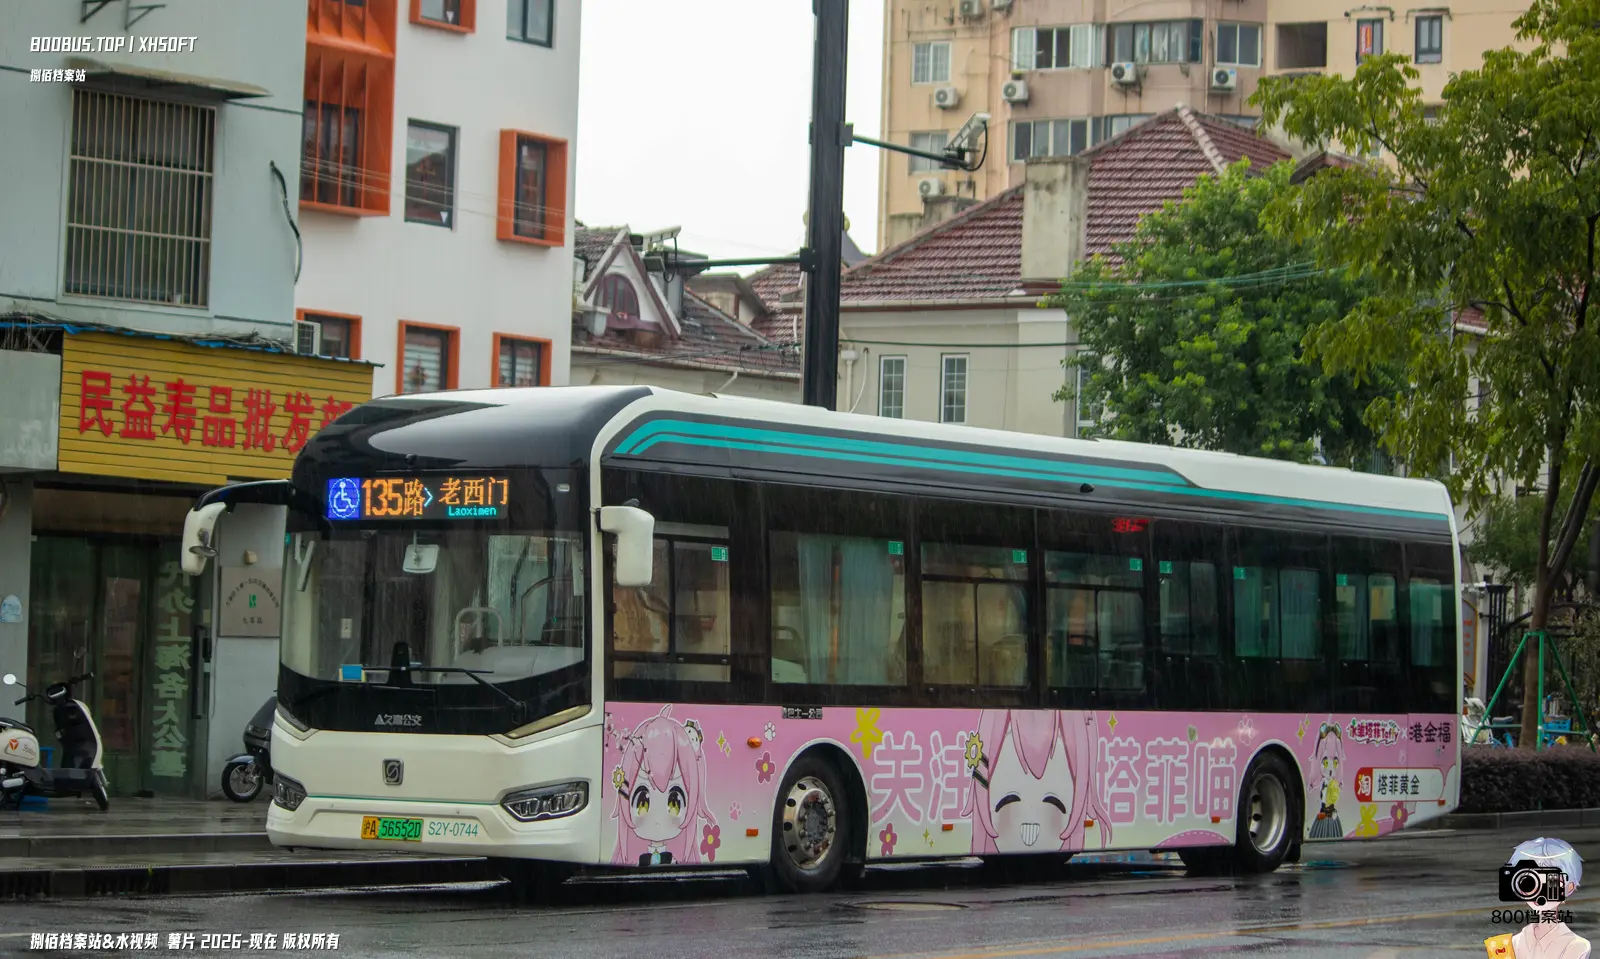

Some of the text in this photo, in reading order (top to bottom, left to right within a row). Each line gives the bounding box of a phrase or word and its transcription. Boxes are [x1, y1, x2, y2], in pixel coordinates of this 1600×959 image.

[361, 478, 426, 517] 135路
[439, 476, 509, 506] 老西门
[448, 505, 497, 517] Laoximen
[1409, 721, 1451, 743] 港金福
[1098, 736, 1238, 825] 塔菲喵
[1377, 774, 1420, 795] 塔菲黄金
[428, 821, 479, 837] S2Y-0744
